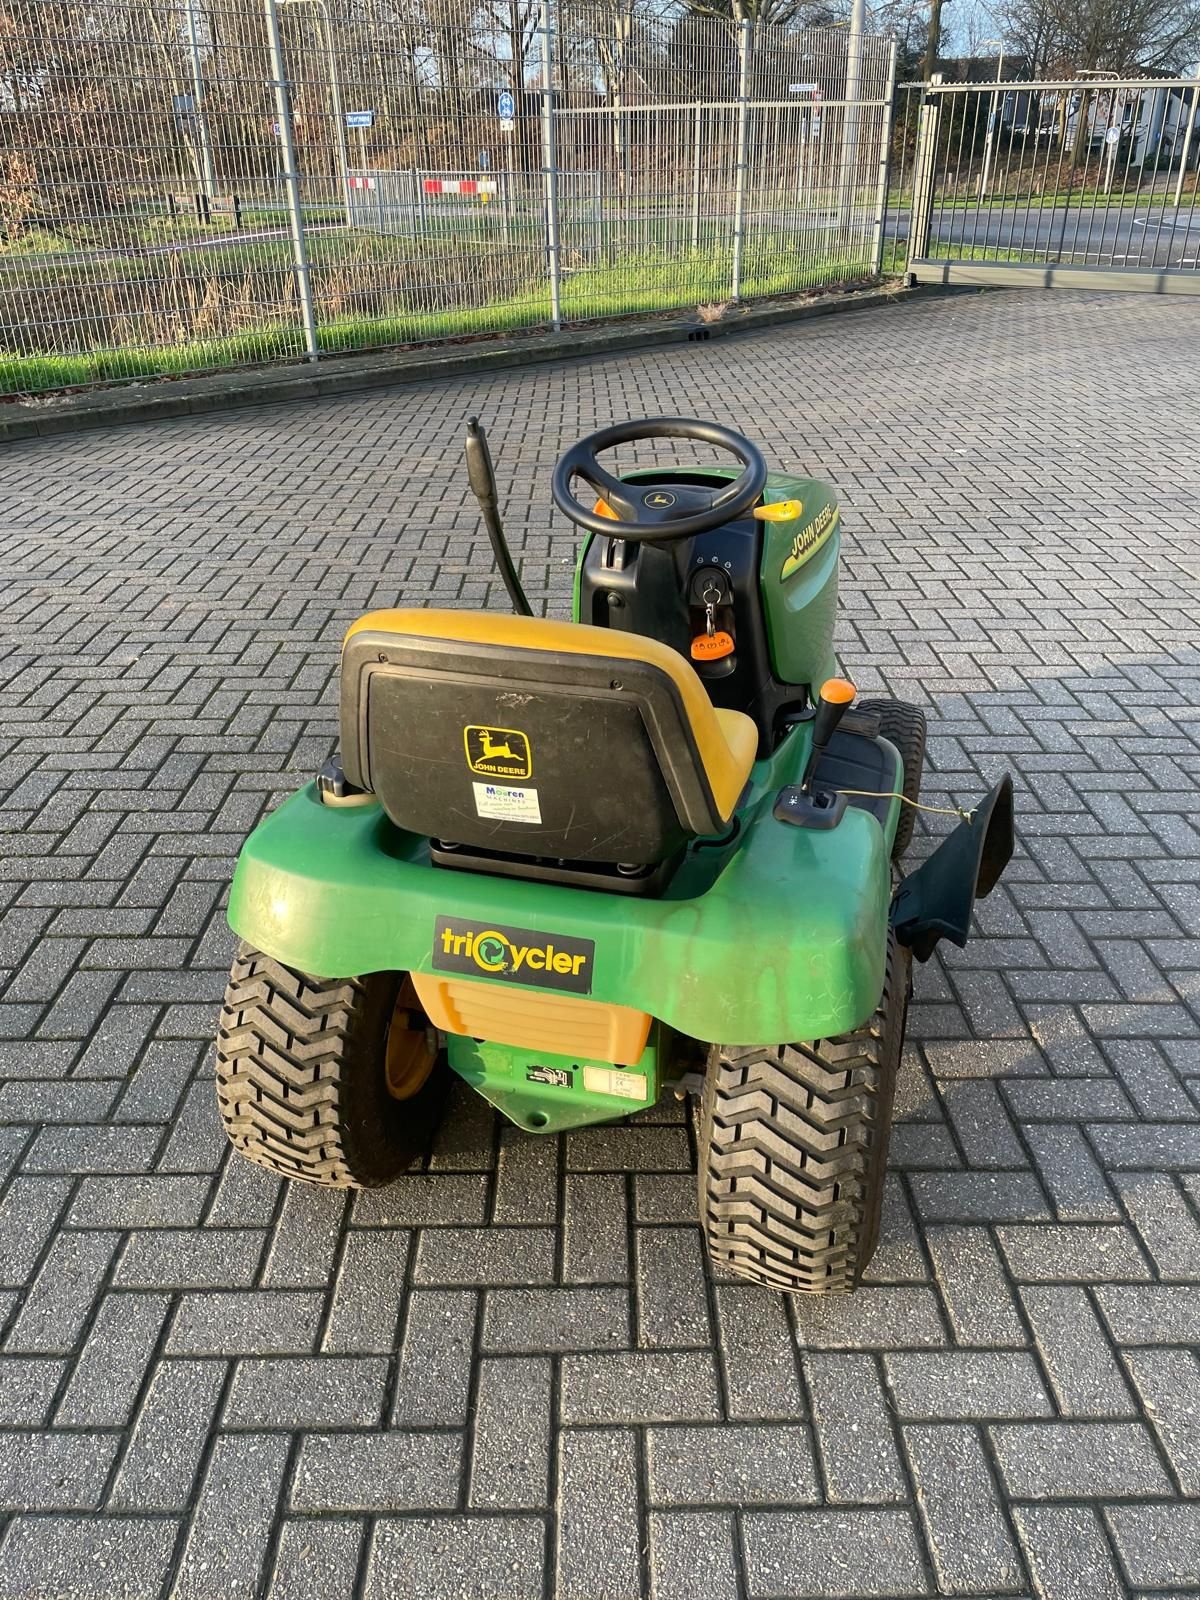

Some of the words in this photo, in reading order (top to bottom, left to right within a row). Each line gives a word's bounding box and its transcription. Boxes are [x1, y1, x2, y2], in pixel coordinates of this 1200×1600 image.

[792, 522, 815, 556] JOHN
[815, 503, 832, 534] DEERE
[473, 763, 497, 772] JOHN
[497, 766, 526, 775] DEERE
